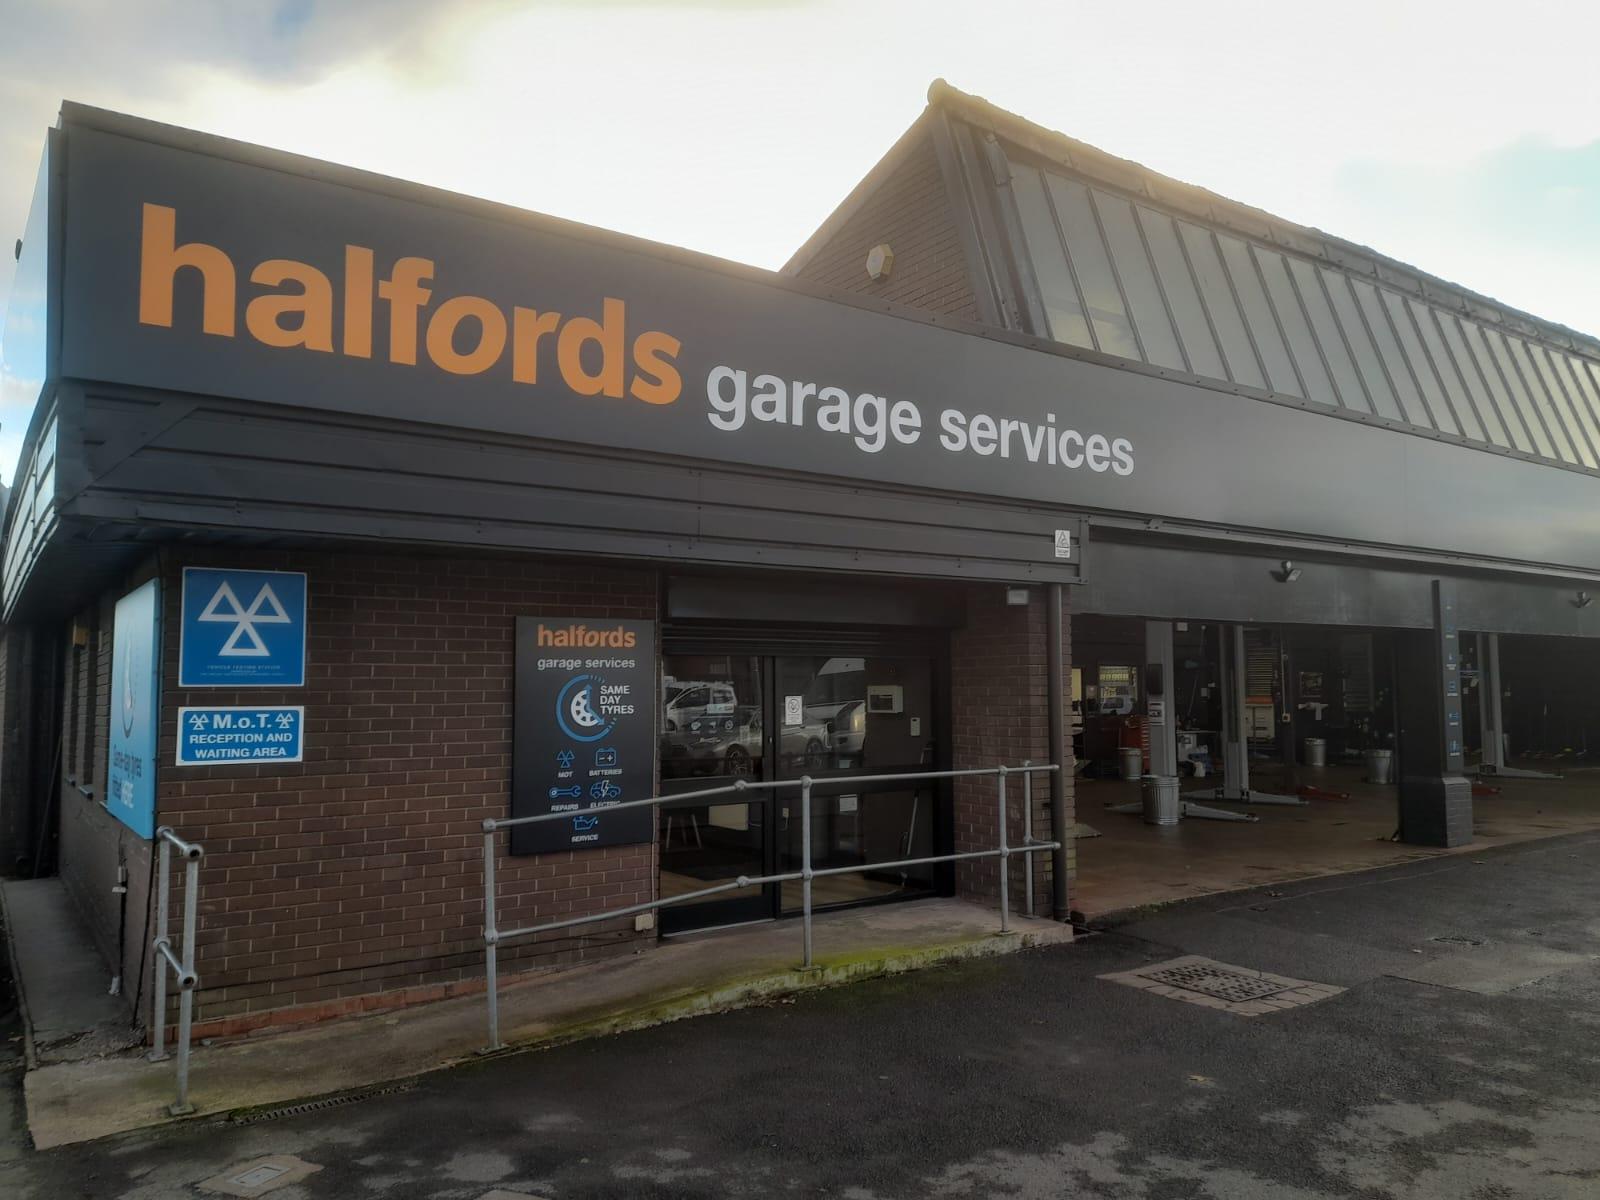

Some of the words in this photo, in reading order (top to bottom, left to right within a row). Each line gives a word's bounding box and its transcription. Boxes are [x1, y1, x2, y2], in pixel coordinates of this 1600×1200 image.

[139, 202, 682, 405] halfords
[706, 365, 922, 453] garage
[939, 413, 1135, 476] services
[537, 624, 636, 648] halfords
[537, 658, 582, 670] garage
[585, 656, 636, 668] services
[600, 685, 630, 695] SAME
[600, 696, 621, 704] DAY
[600, 705, 635, 714] TYRES
[213, 714, 272, 729] M.o.T.
[189, 734, 263, 744] RECEPTION
[266, 733, 293, 742] AND
[195, 748, 250, 759] WAITING
[252, 747, 287, 757] AREA
[589, 768, 622, 776] BATTERIES
[571, 834, 599, 842] SERVICE
